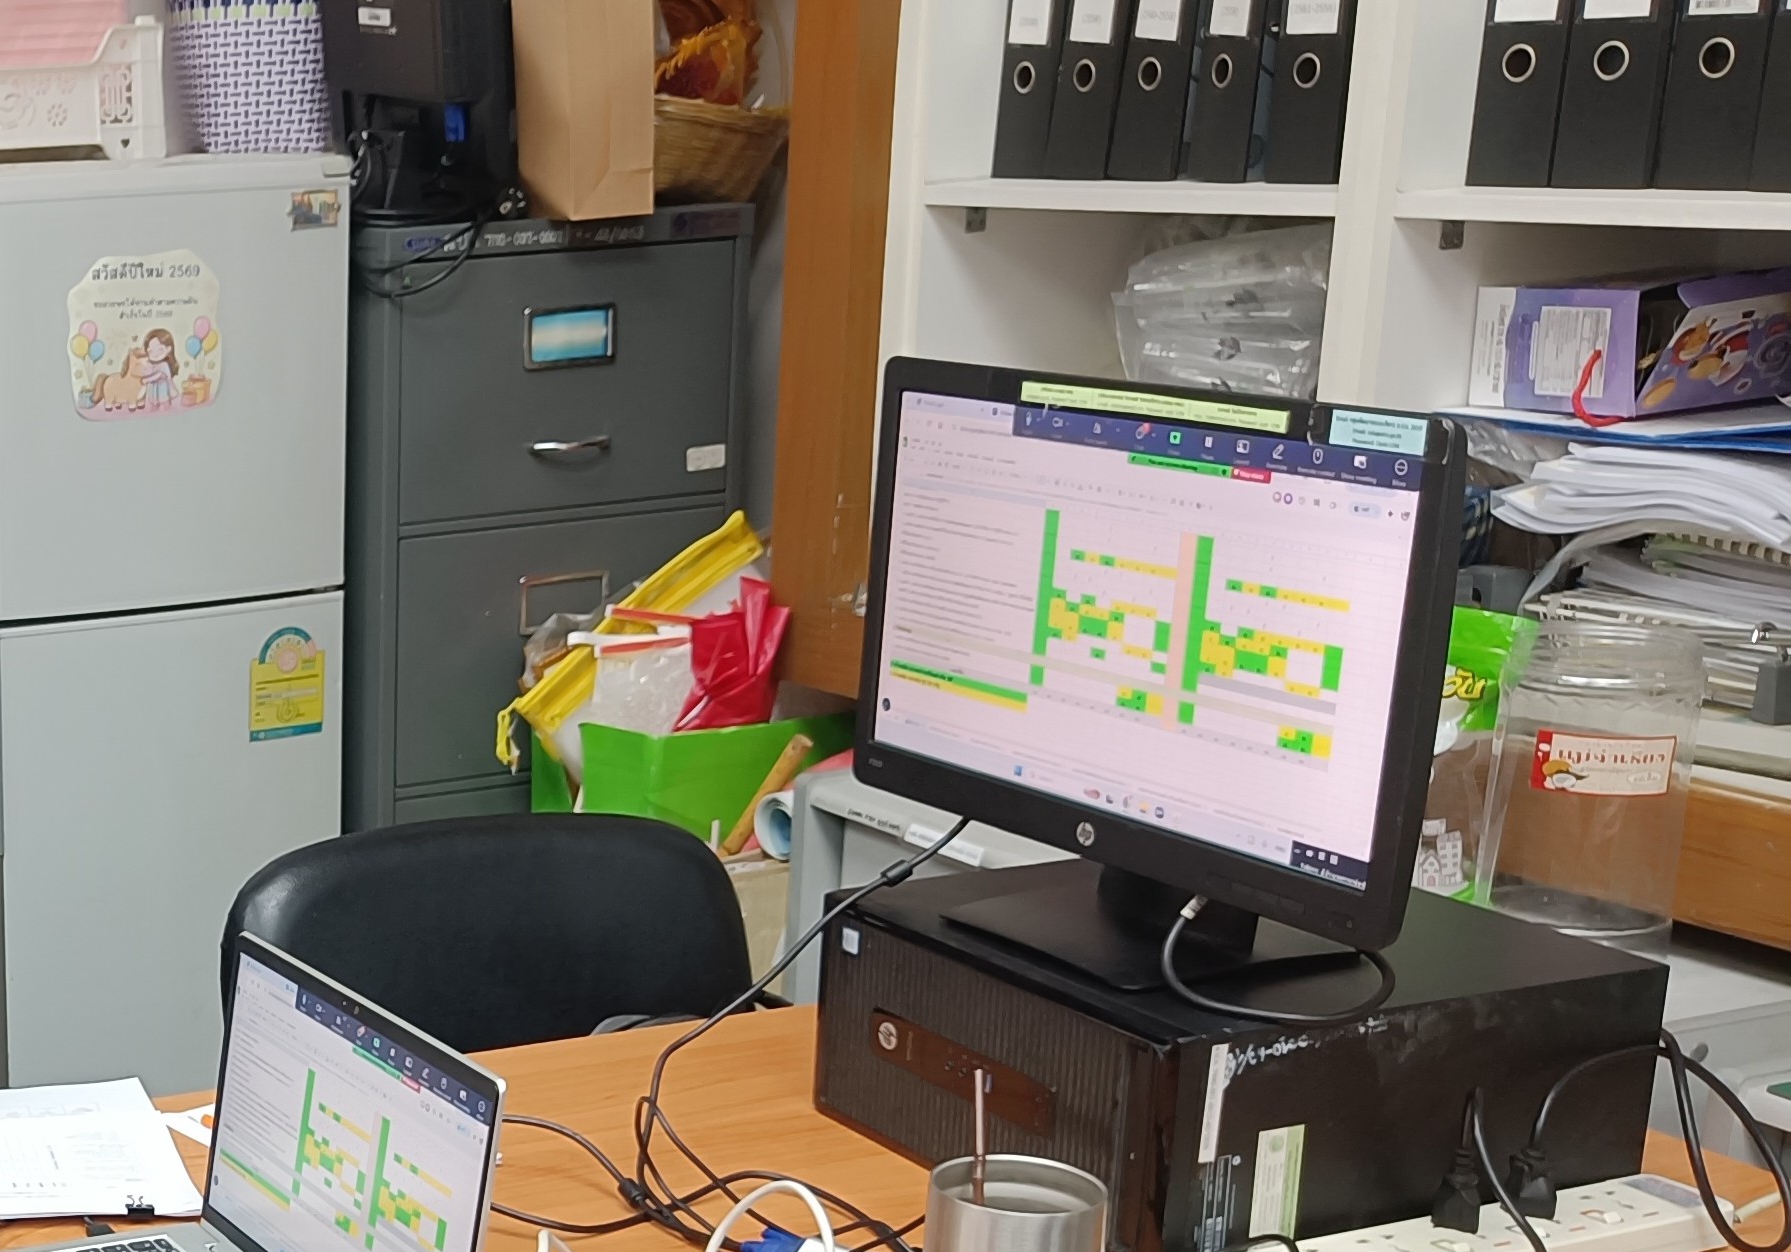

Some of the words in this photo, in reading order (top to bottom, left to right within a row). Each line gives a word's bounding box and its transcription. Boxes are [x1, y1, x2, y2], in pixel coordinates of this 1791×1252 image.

[91, 261, 165, 282] สวัสดีปีใหม่
[168, 264, 201, 279] 2569
